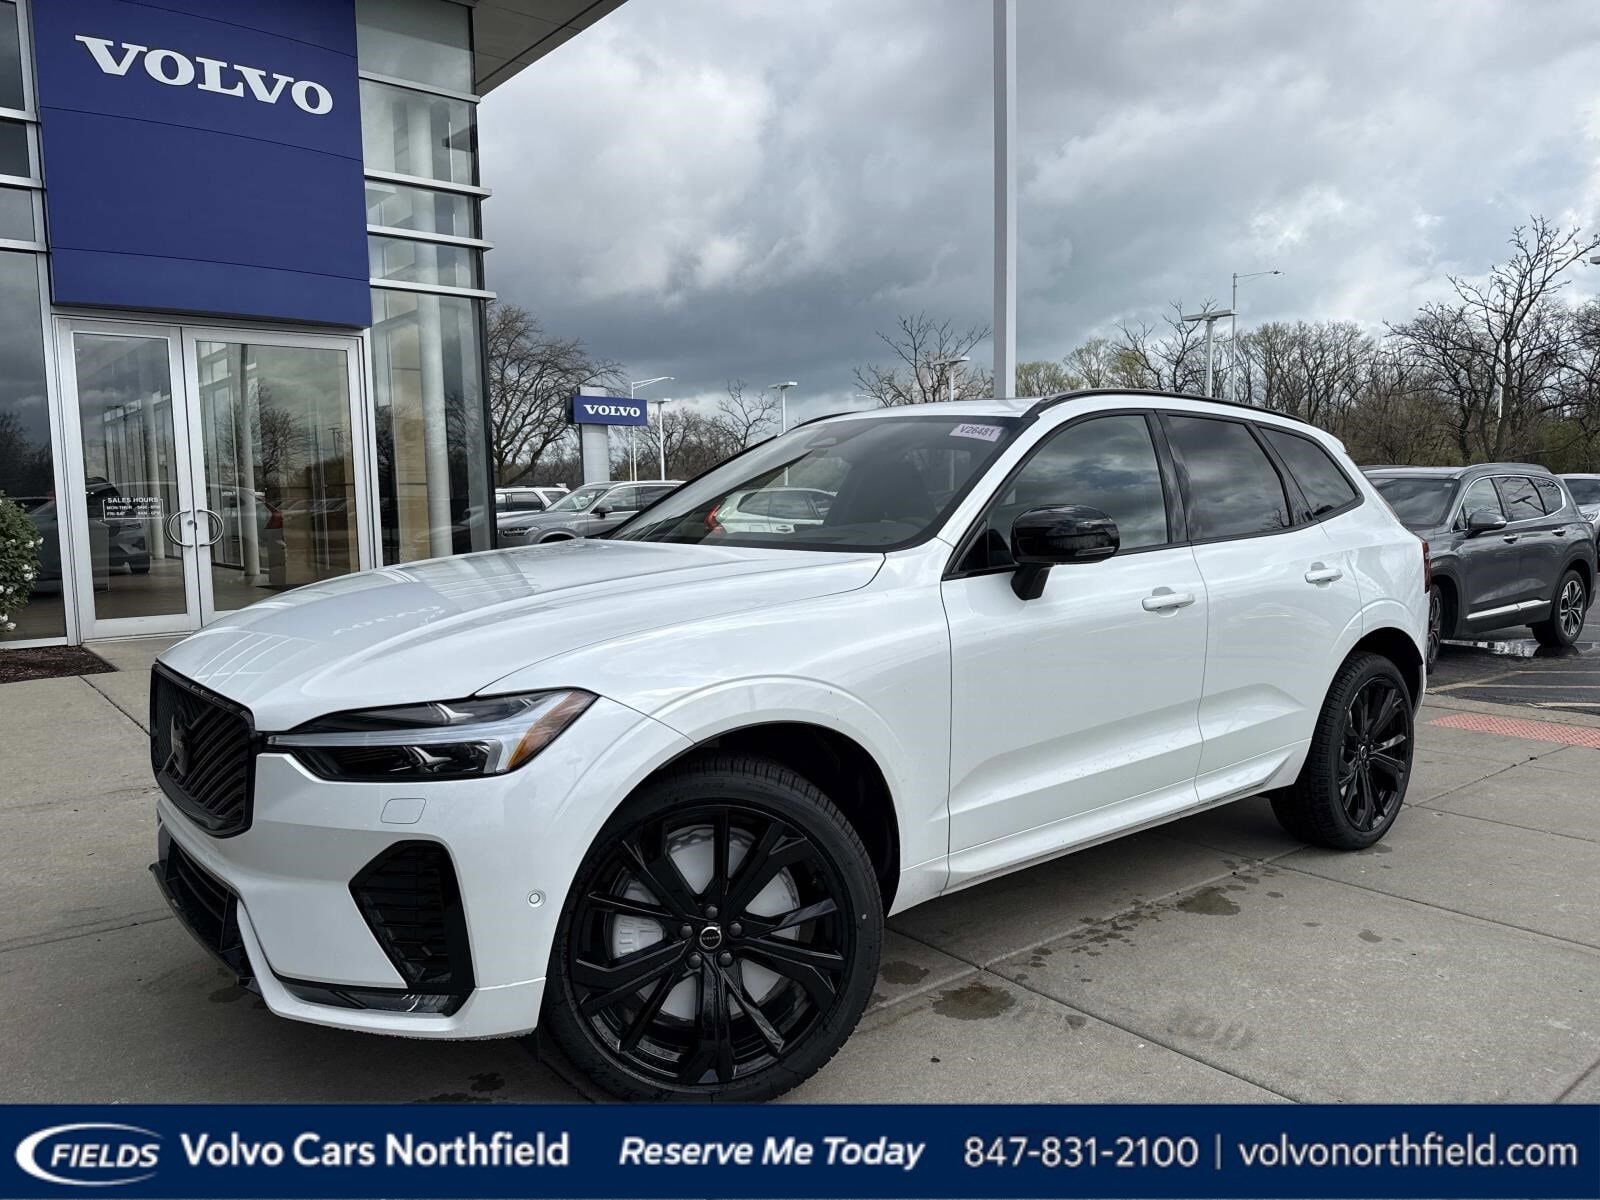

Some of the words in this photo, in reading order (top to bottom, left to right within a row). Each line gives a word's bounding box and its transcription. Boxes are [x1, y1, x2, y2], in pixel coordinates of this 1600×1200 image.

[74, 34, 334, 116] VOLVO
[583, 404, 641, 418] VOLVO
[960, 425, 996, 437] V26481
